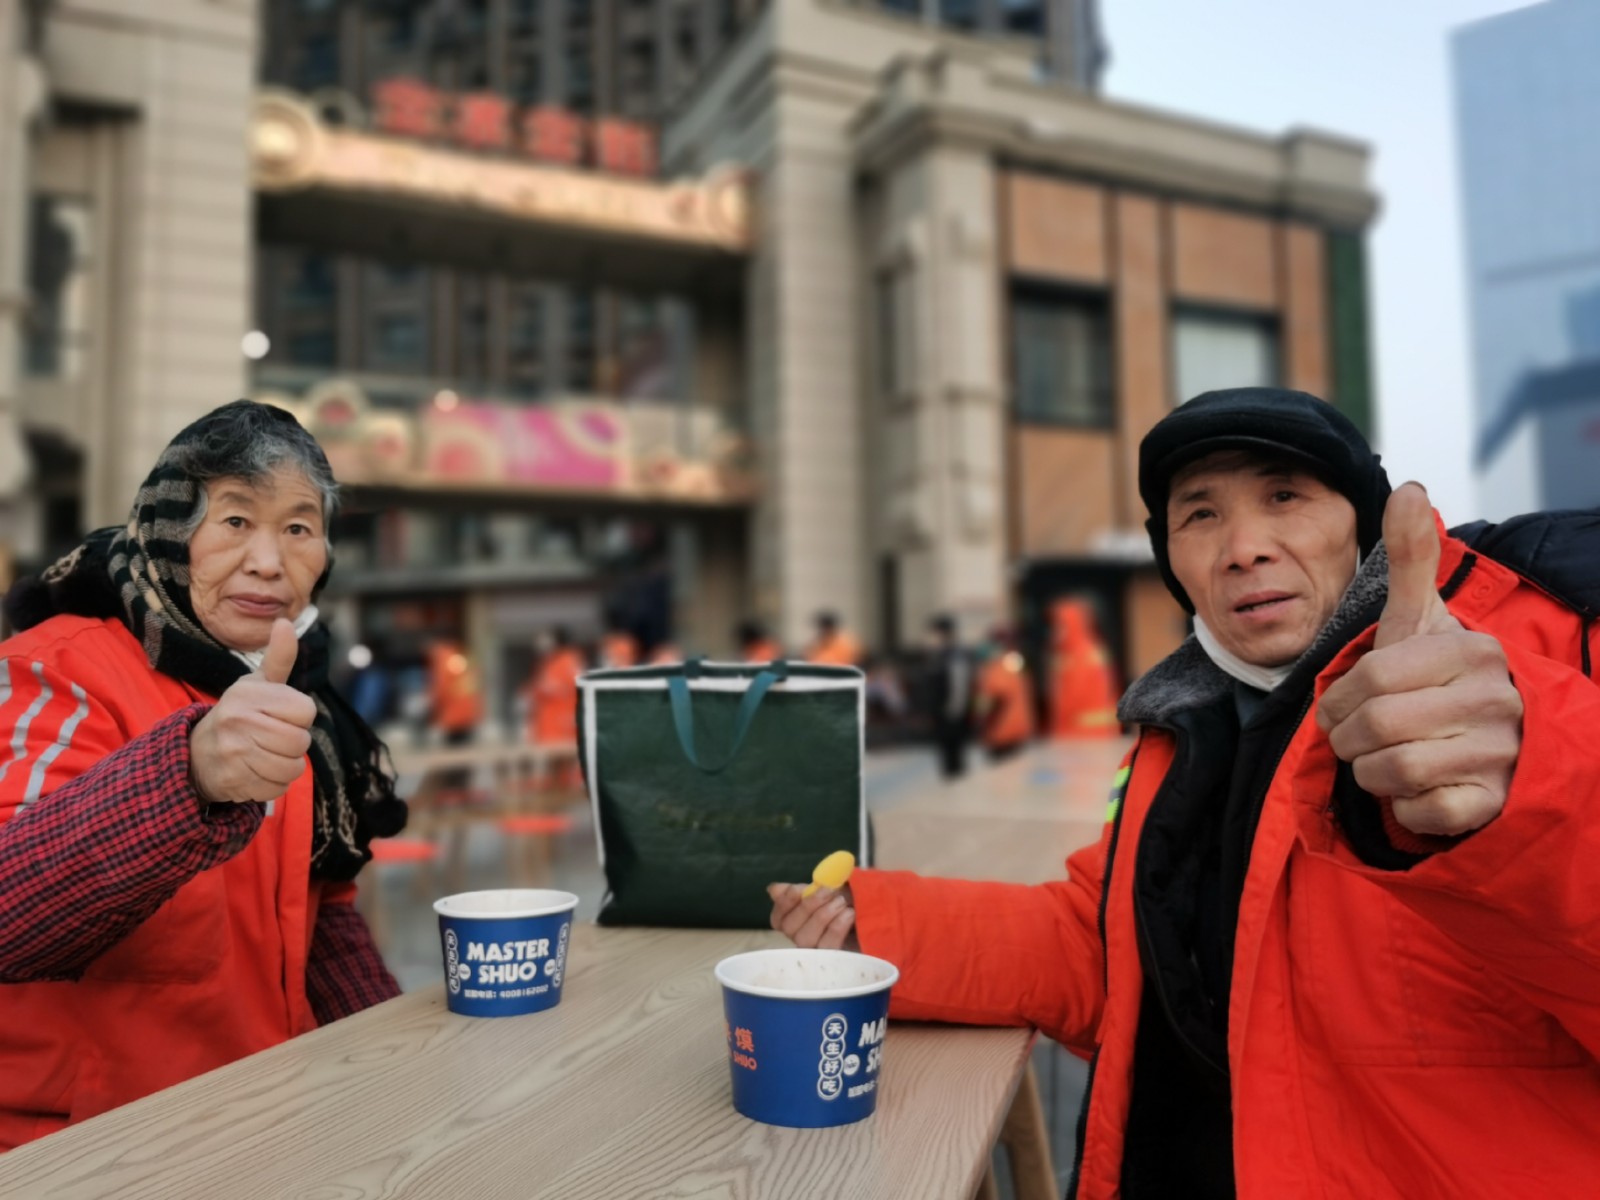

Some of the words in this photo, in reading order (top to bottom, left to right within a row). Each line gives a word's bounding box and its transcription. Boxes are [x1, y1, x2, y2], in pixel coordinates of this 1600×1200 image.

[466, 938, 550, 962] MASTER
[478, 961, 537, 984] SHUO
[821, 1022, 842, 1094] 天生好吃
